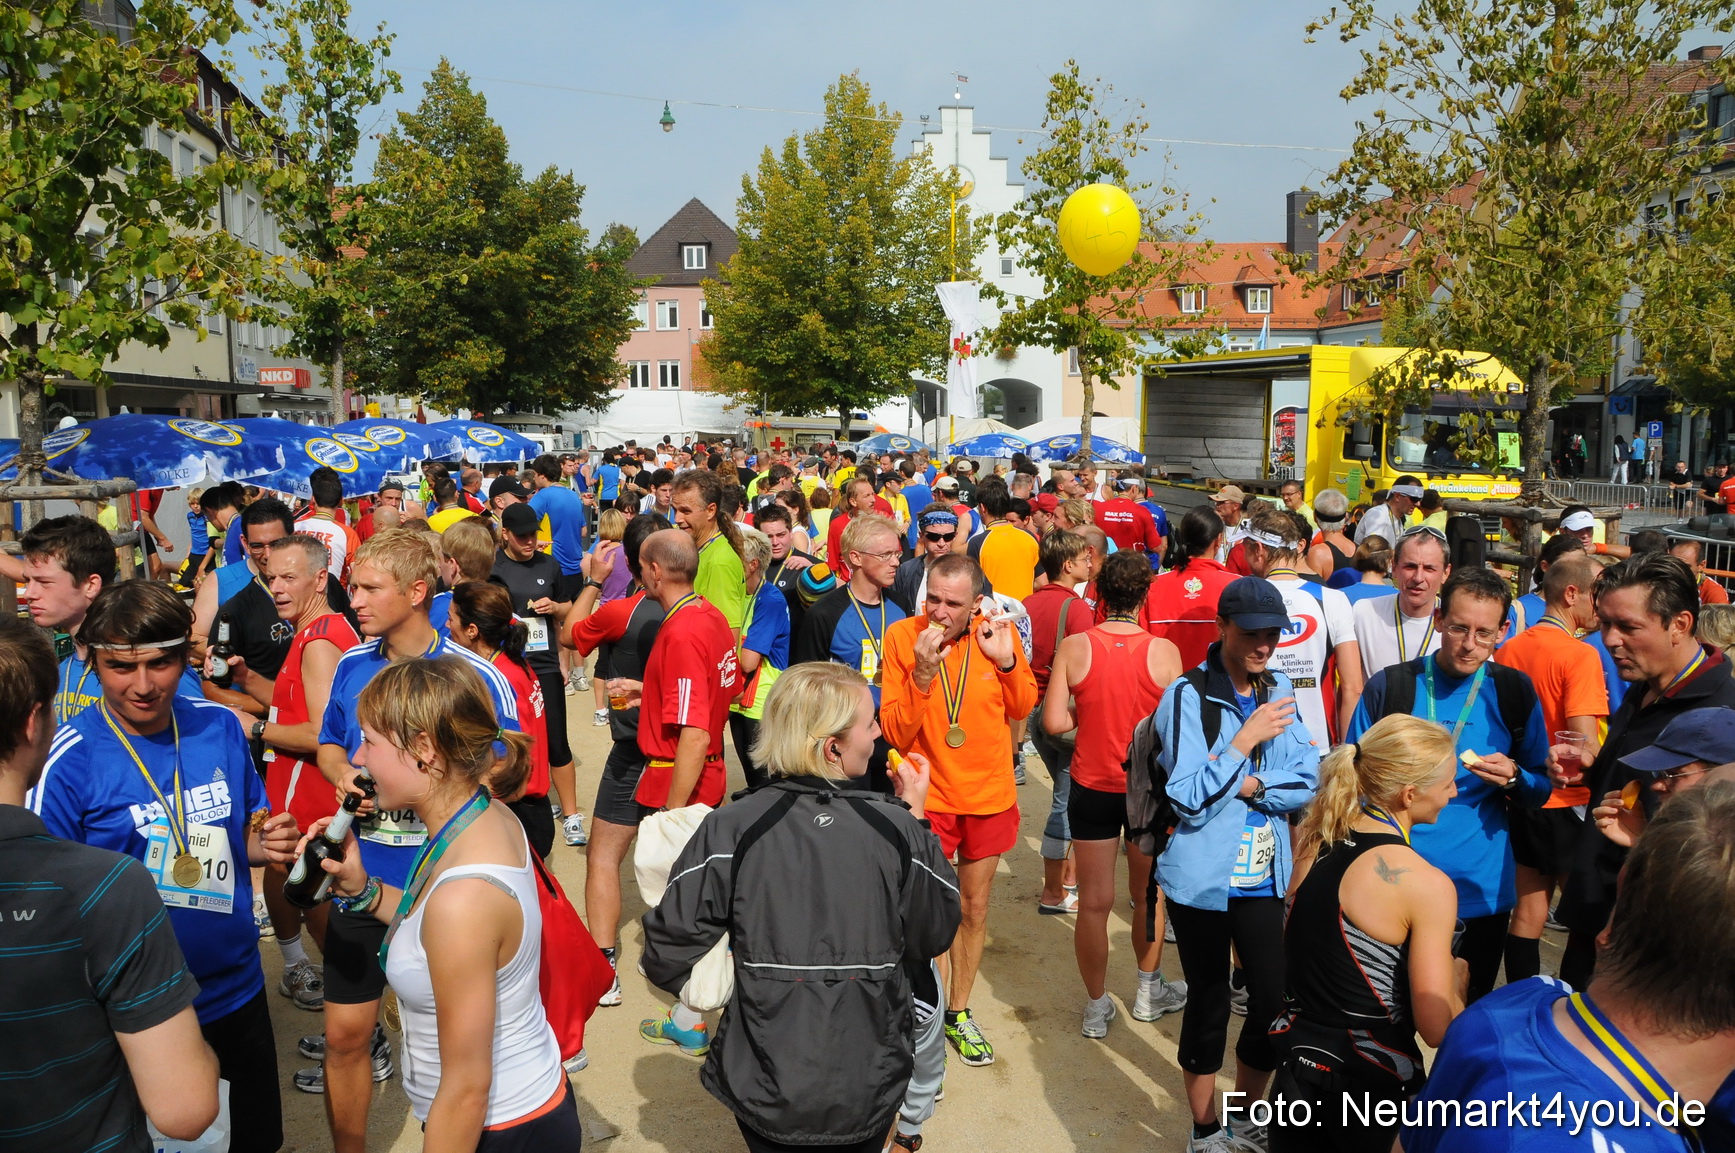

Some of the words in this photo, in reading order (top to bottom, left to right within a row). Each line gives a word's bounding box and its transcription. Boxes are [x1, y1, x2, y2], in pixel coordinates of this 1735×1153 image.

[261, 371, 293, 382] NKD
[1651, 424, 1660, 436] P
[1428, 482, 1489, 494] Getränkeland
[1281, 659, 1314, 667] klinikum
[151, 847, 159, 859] B
[199, 896, 232, 908] PFLEIDERER
